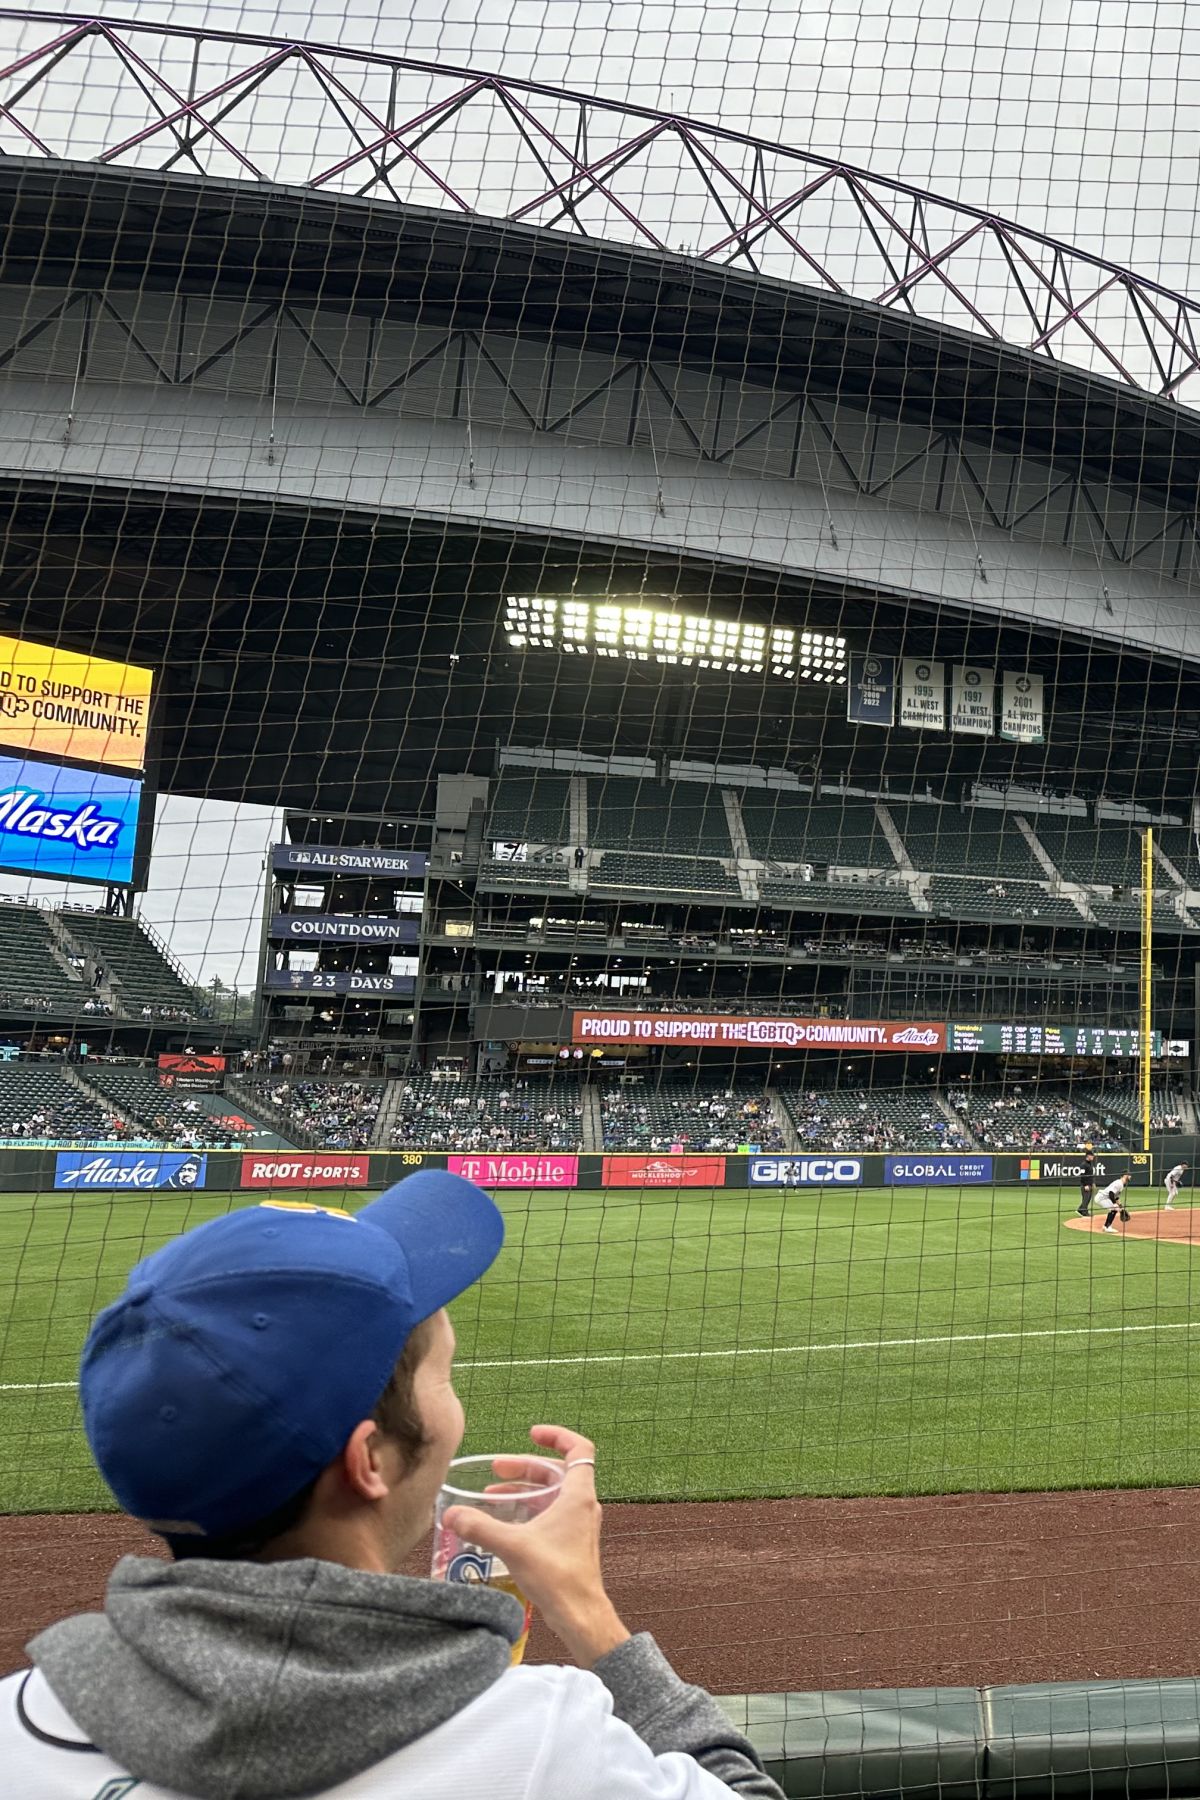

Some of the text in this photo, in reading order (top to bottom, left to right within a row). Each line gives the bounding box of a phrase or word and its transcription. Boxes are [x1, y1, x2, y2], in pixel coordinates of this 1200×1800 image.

[17, 674, 36, 693] TO
[41, 679, 112, 709] SUPPORT
[116, 695, 144, 715] THE
[914, 685, 933, 697] 1995
[964, 690, 982, 703] 1997
[863, 698, 880, 706] 2022
[907, 698, 939, 710] A.L. WEST
[1013, 696, 1032, 709] 2001
[957, 703, 988, 716] A.L. WEST
[1007, 709, 1038, 721] A.L. WEST
[32, 700, 141, 738] COMMUNITY.
[902, 710, 943, 724] CHAMPIONS
[953, 716, 992, 729] CHAMPIONS
[1003, 721, 1041, 734] CHAMPIONS
[372, 857, 409, 870] WEEK
[290, 921, 401, 938] COUNTDOWN
[350, 976, 394, 989] DAYS
[581, 1018, 939, 1045] PROUD TO SUPPORT THE LGBTQ+ COMMUNITY. Alaska
[402, 1154, 422, 1165] 380
[1132, 1155, 1147, 1165] 326
[62, 1158, 158, 1186] Alaska
[252, 1163, 302, 1178] ROOT
[487, 1161, 565, 1182] Mobile
[893, 1164, 956, 1177] GLOBAL
[1043, 1162, 1106, 1177] Microft
